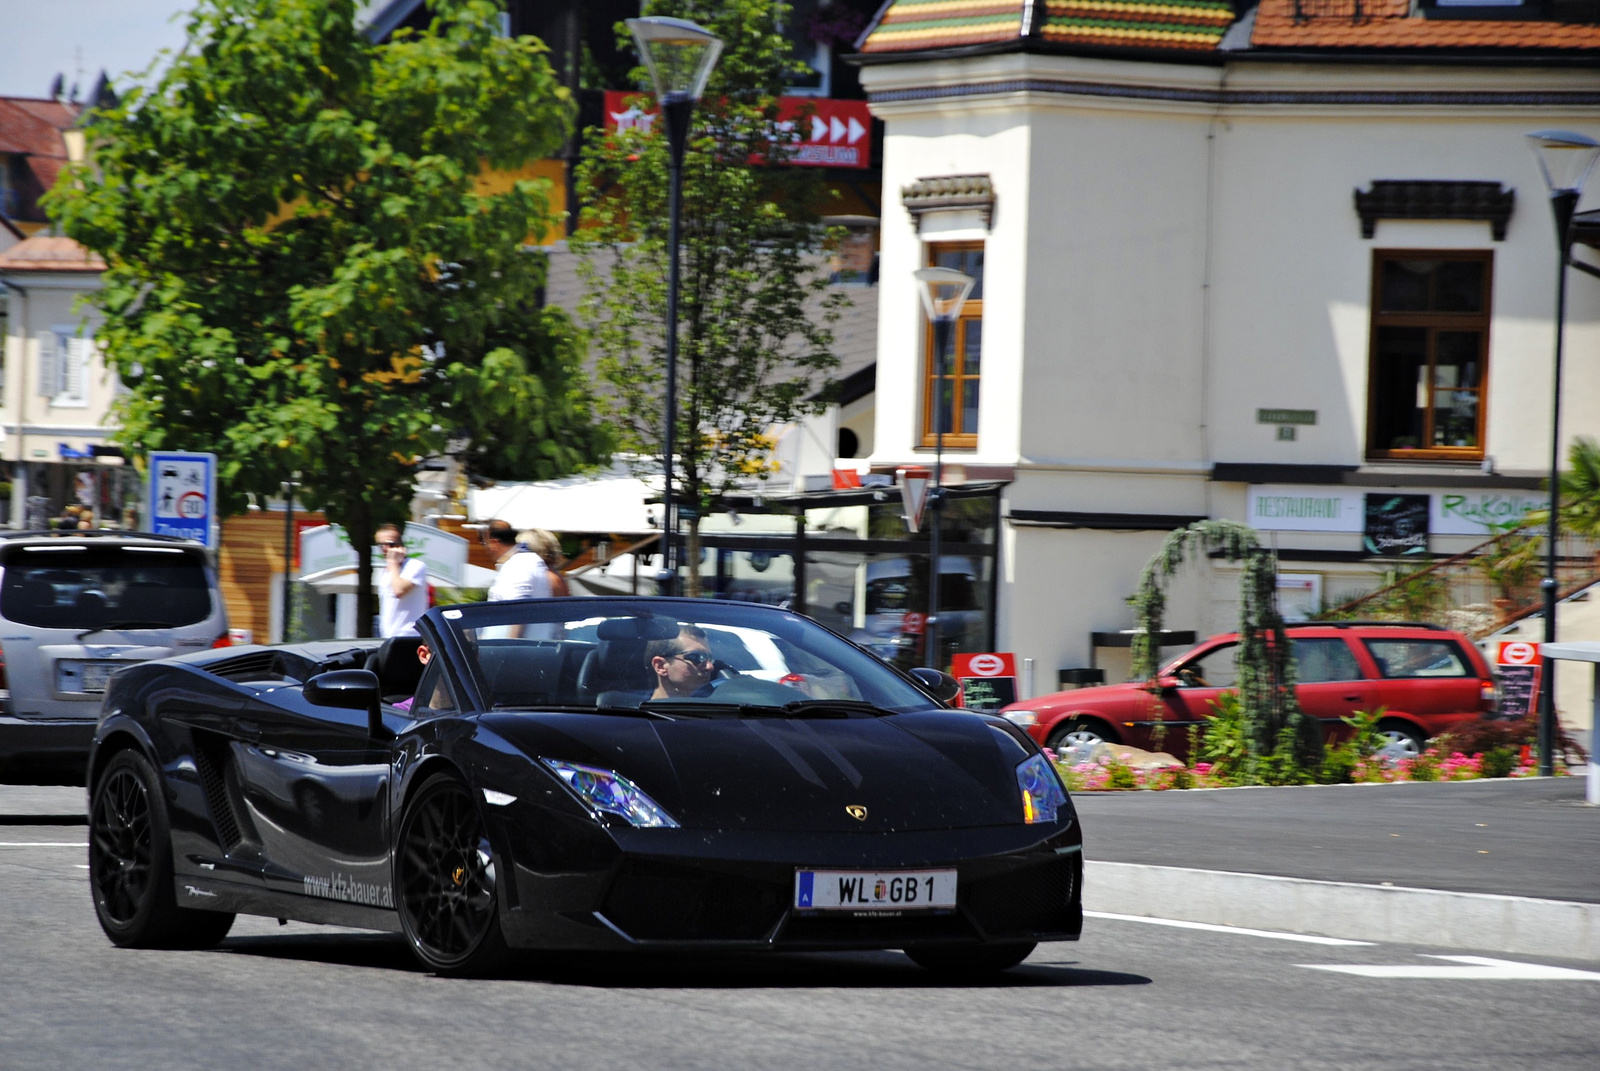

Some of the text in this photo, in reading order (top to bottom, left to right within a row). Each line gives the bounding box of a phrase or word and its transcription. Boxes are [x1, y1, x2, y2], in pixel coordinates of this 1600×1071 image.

[1256, 496, 1341, 518] RESTAURANT
[303, 872, 394, 908] www.kfz-bauer.at
[802, 893, 809, 902] A
[839, 876, 869, 903] WL
